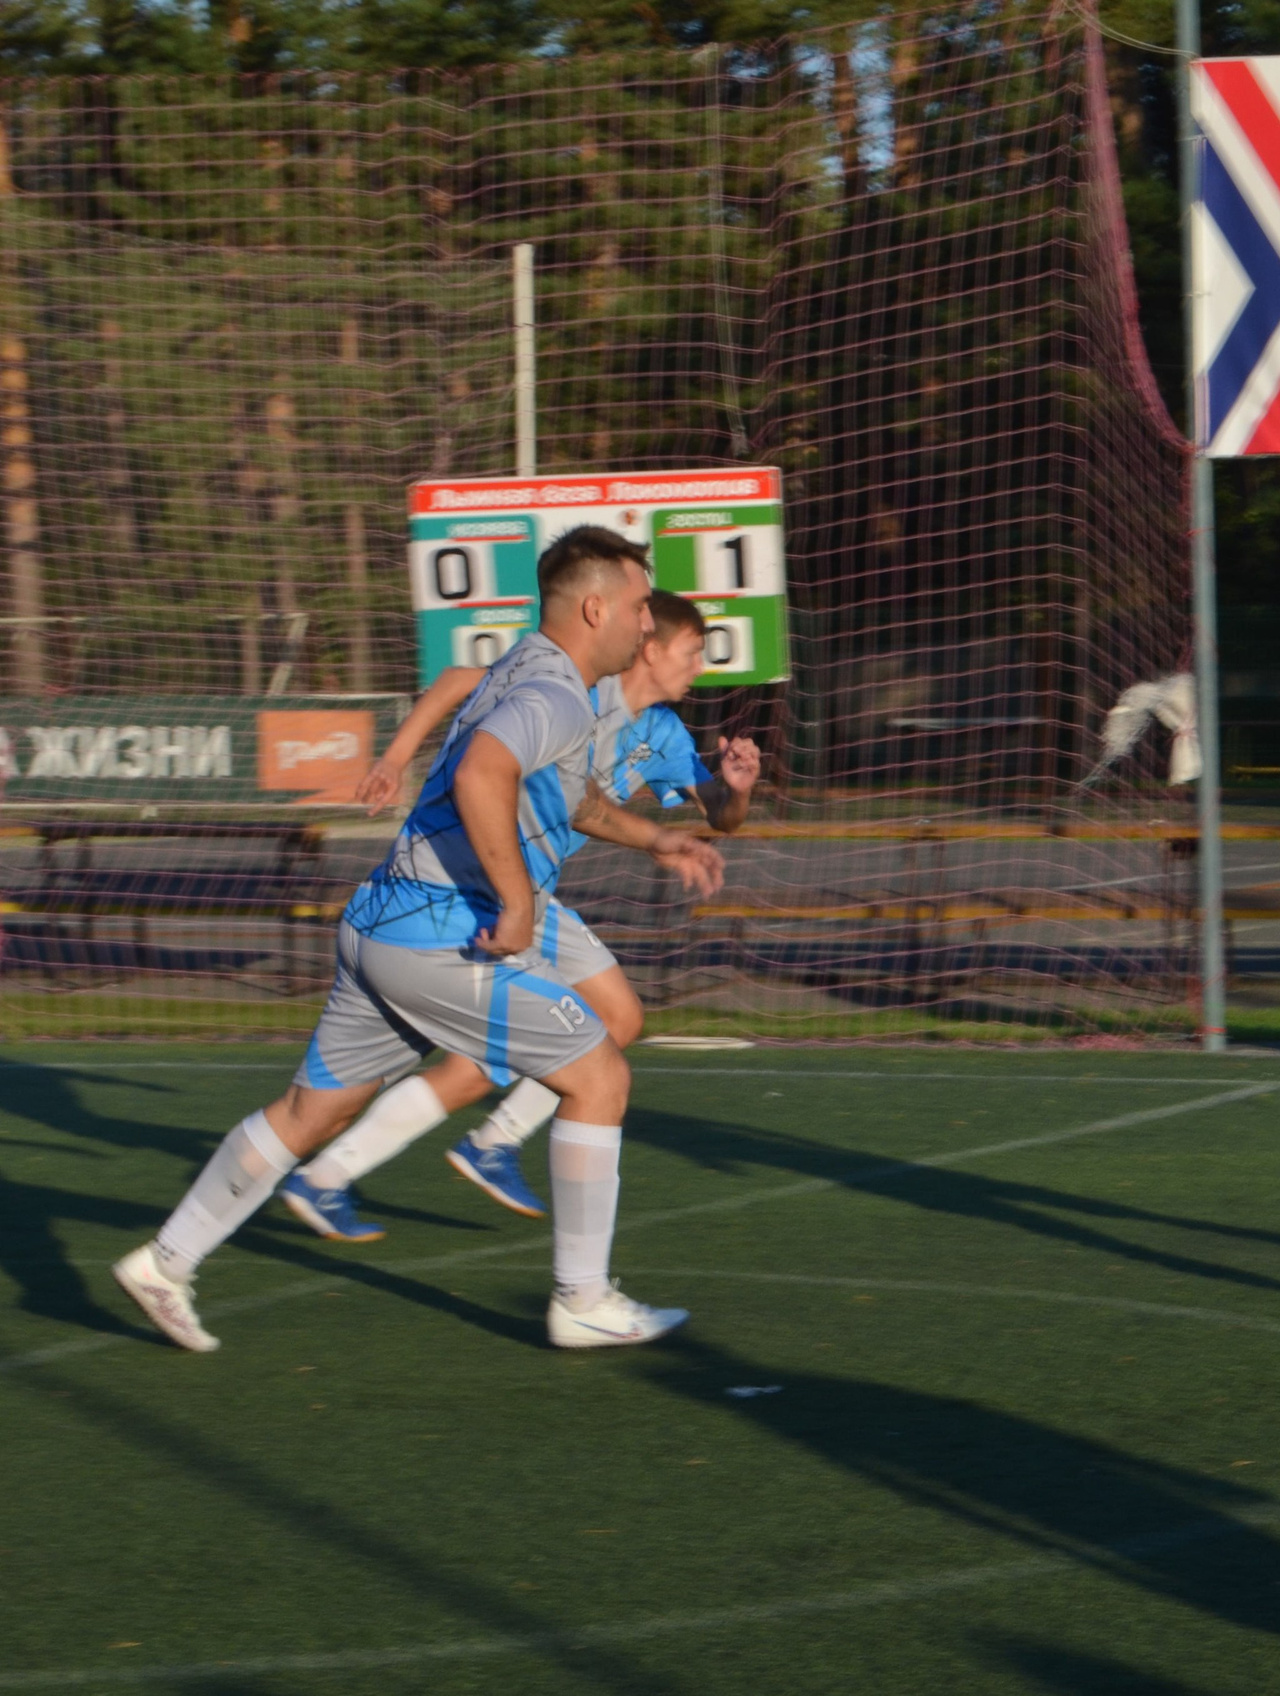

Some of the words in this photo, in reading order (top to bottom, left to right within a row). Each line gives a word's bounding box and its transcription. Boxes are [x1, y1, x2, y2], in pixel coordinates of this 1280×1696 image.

[430, 547, 472, 599] 0
[719, 535, 753, 589] 1
[25, 726, 233, 778] ЖИЗНИ
[548, 994, 587, 1035] 13
